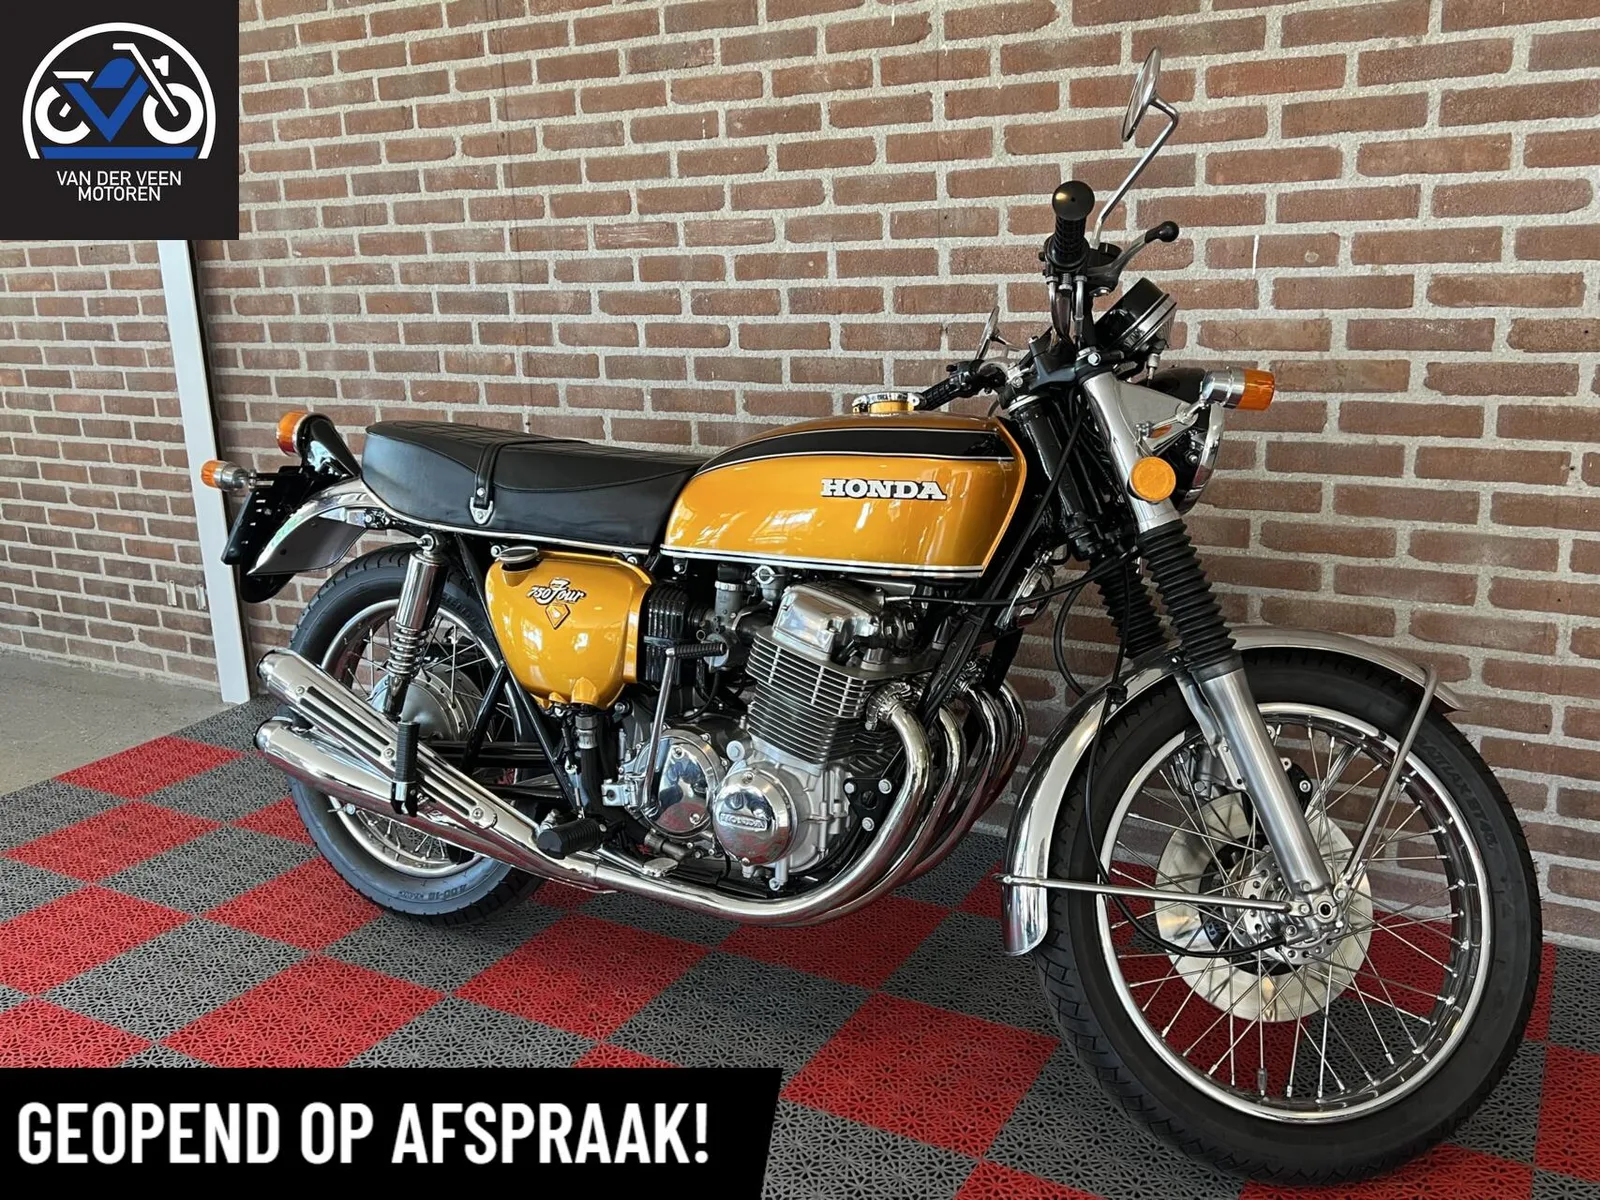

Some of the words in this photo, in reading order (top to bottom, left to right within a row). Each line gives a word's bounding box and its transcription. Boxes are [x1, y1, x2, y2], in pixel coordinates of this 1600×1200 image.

[820, 478, 947, 500] HONDA
[526, 585, 553, 600] 750
[536, 578, 586, 605] Four
